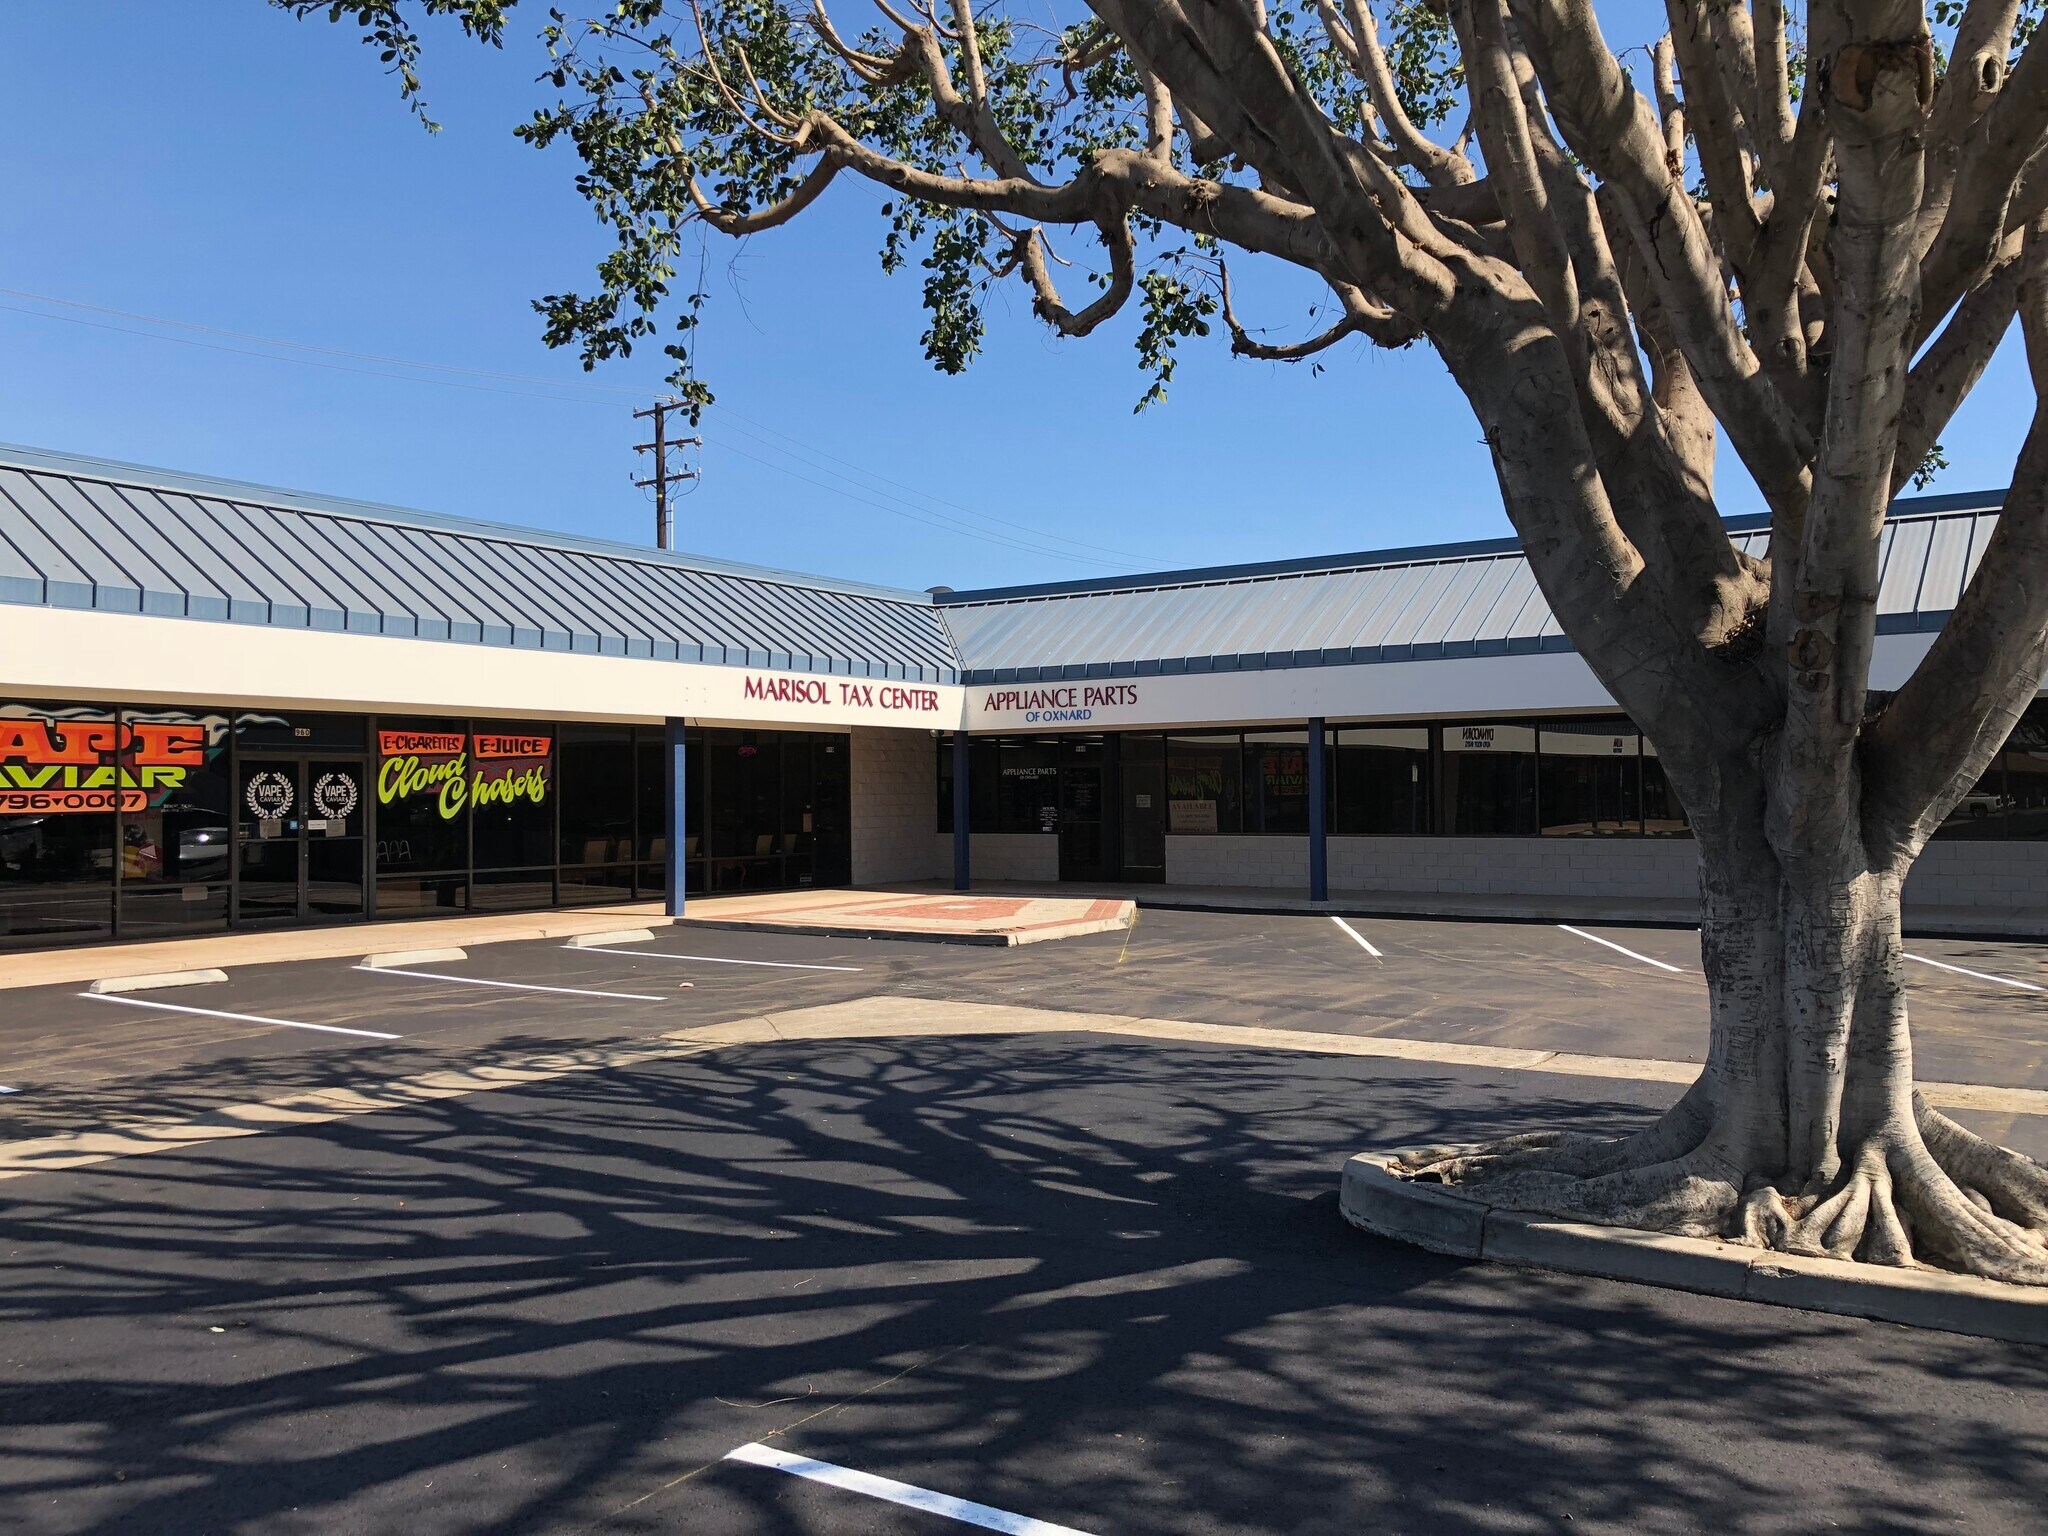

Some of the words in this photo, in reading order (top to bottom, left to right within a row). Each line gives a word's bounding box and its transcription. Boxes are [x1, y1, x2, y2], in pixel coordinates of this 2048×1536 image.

[744, 675, 831, 705] MARISOL
[839, 683, 873, 707] TAX
[880, 687, 939, 711] CENTER
[984, 688, 1077, 711] APPLIANCE
[1084, 685, 1138, 707] PARTS
[1026, 711, 1040, 722] OF
[1043, 709, 1092, 721] OXNARD
[384, 733, 460, 751] E-CIGARETTES
[378, 753, 467, 804] Cloud
[1002, 768, 1036, 776] APPLIANCE
[1037, 767, 1057, 775] PARTS
[259, 785, 282, 797] VAPE
[325, 785, 347, 797] VAPE
[439, 765, 549, 820] Chasers
[1172, 802, 1213, 810] AVAILABLE
